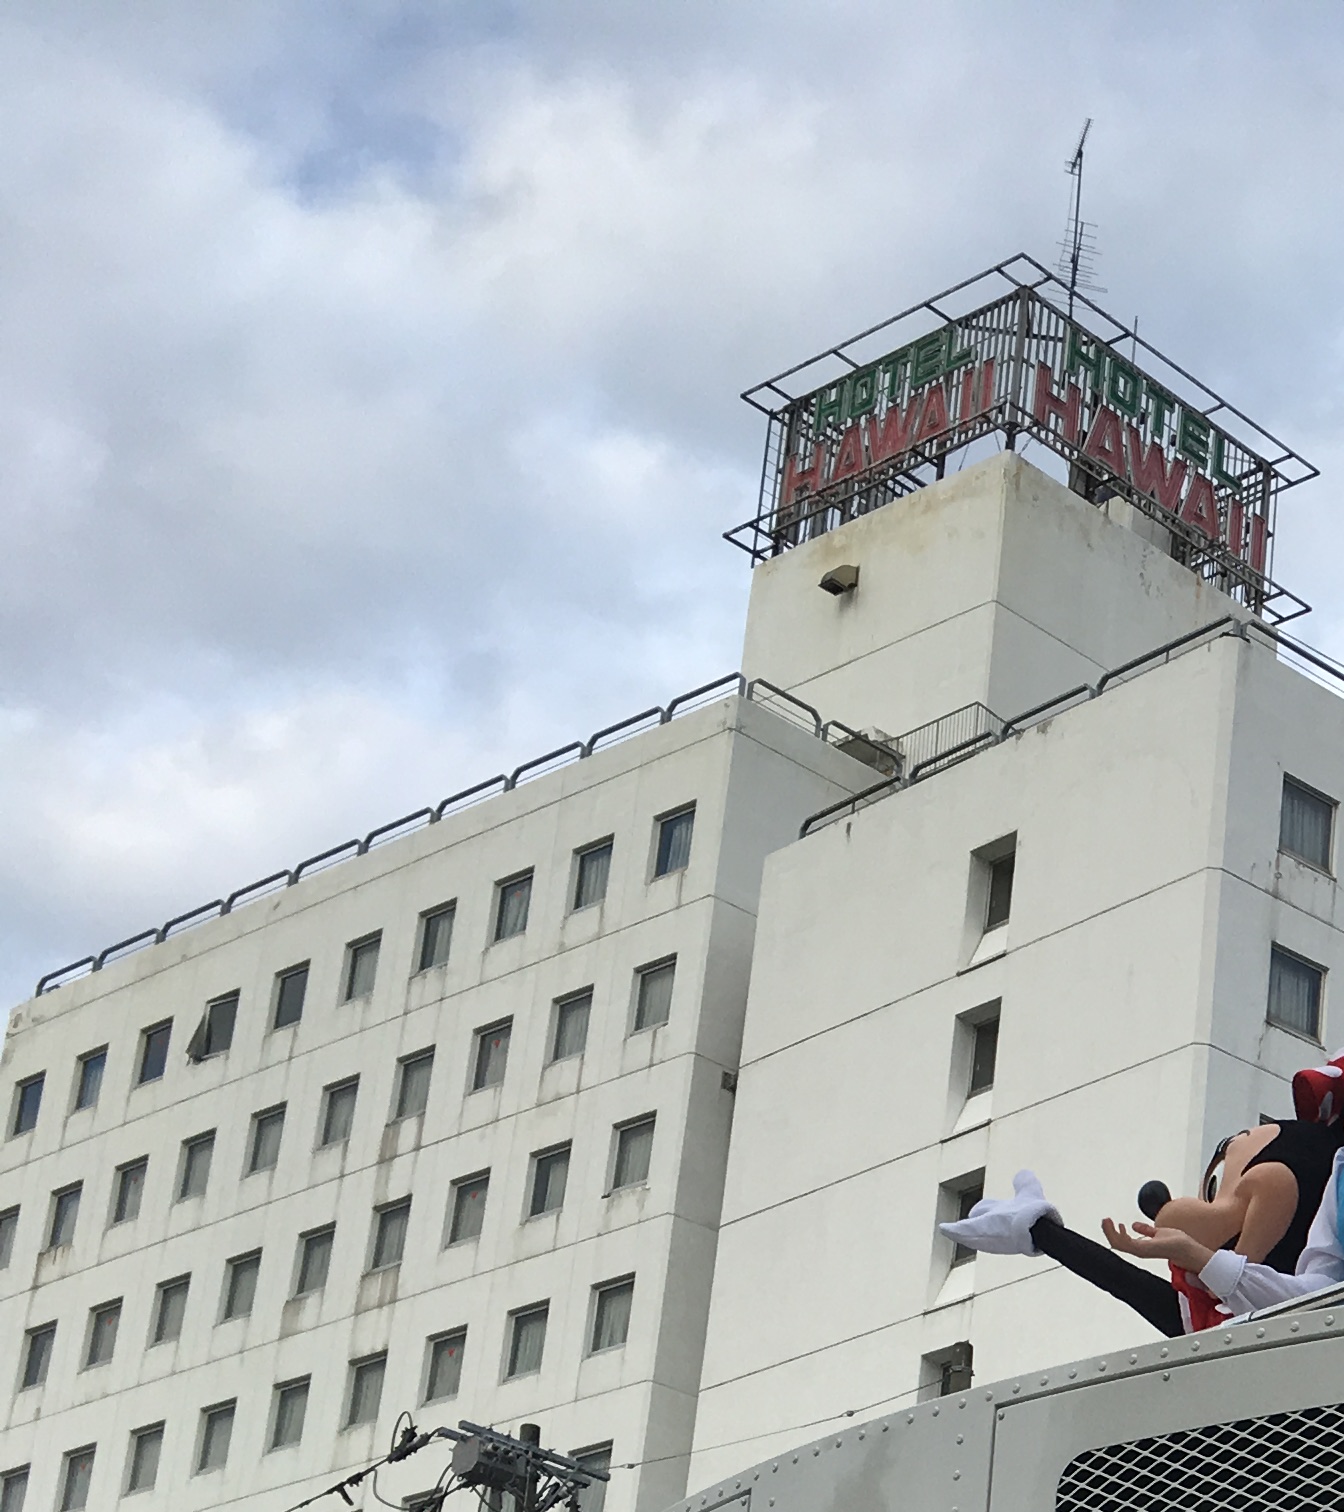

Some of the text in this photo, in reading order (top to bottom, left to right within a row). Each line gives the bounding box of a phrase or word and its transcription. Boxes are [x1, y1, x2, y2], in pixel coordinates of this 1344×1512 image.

[781, 357, 997, 505] HAWAII
[812, 323, 976, 433] HOTEL
[1065, 326, 1242, 493] HOTEL
[1033, 360, 1267, 573] HAWAII
